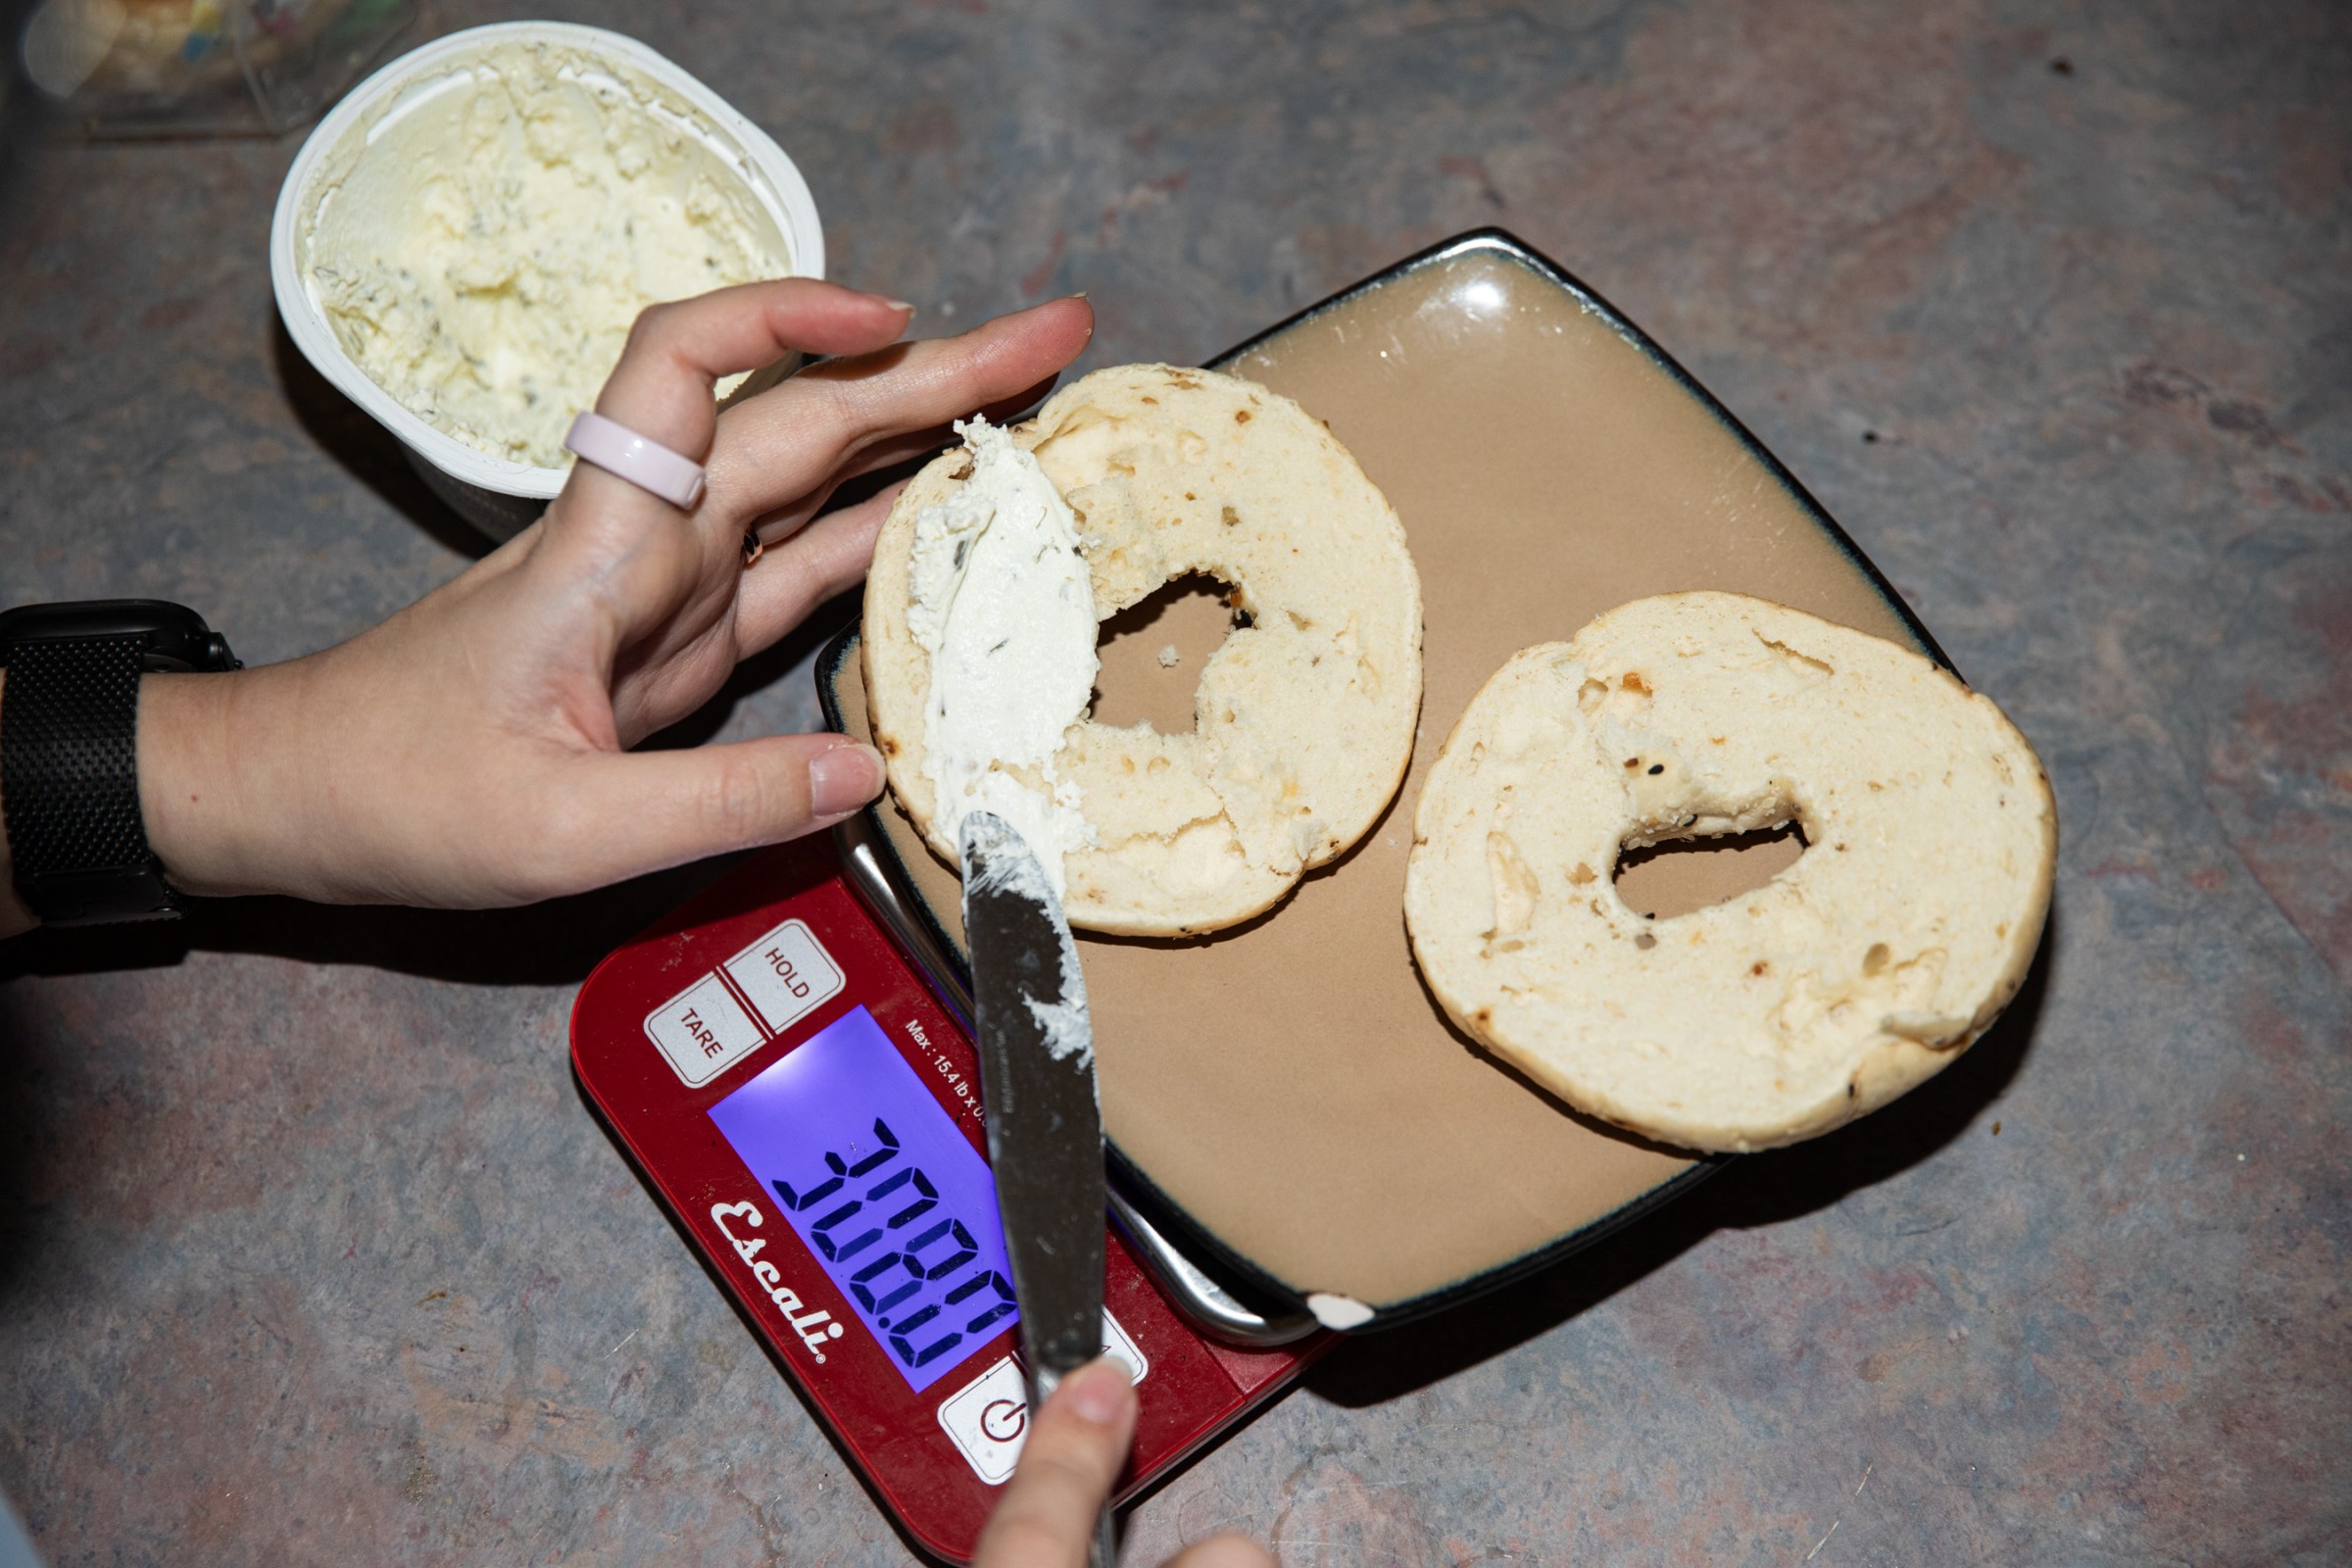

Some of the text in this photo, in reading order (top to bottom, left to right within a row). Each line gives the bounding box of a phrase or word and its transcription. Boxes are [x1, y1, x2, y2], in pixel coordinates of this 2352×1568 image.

[764, 947, 810, 999] HOLD
[680, 1007, 724, 1059] TARE
[934, 1054, 960, 1084] 15.4
[954, 1081, 969, 1098] lb
[771, 1116, 1018, 1369] 308.0
